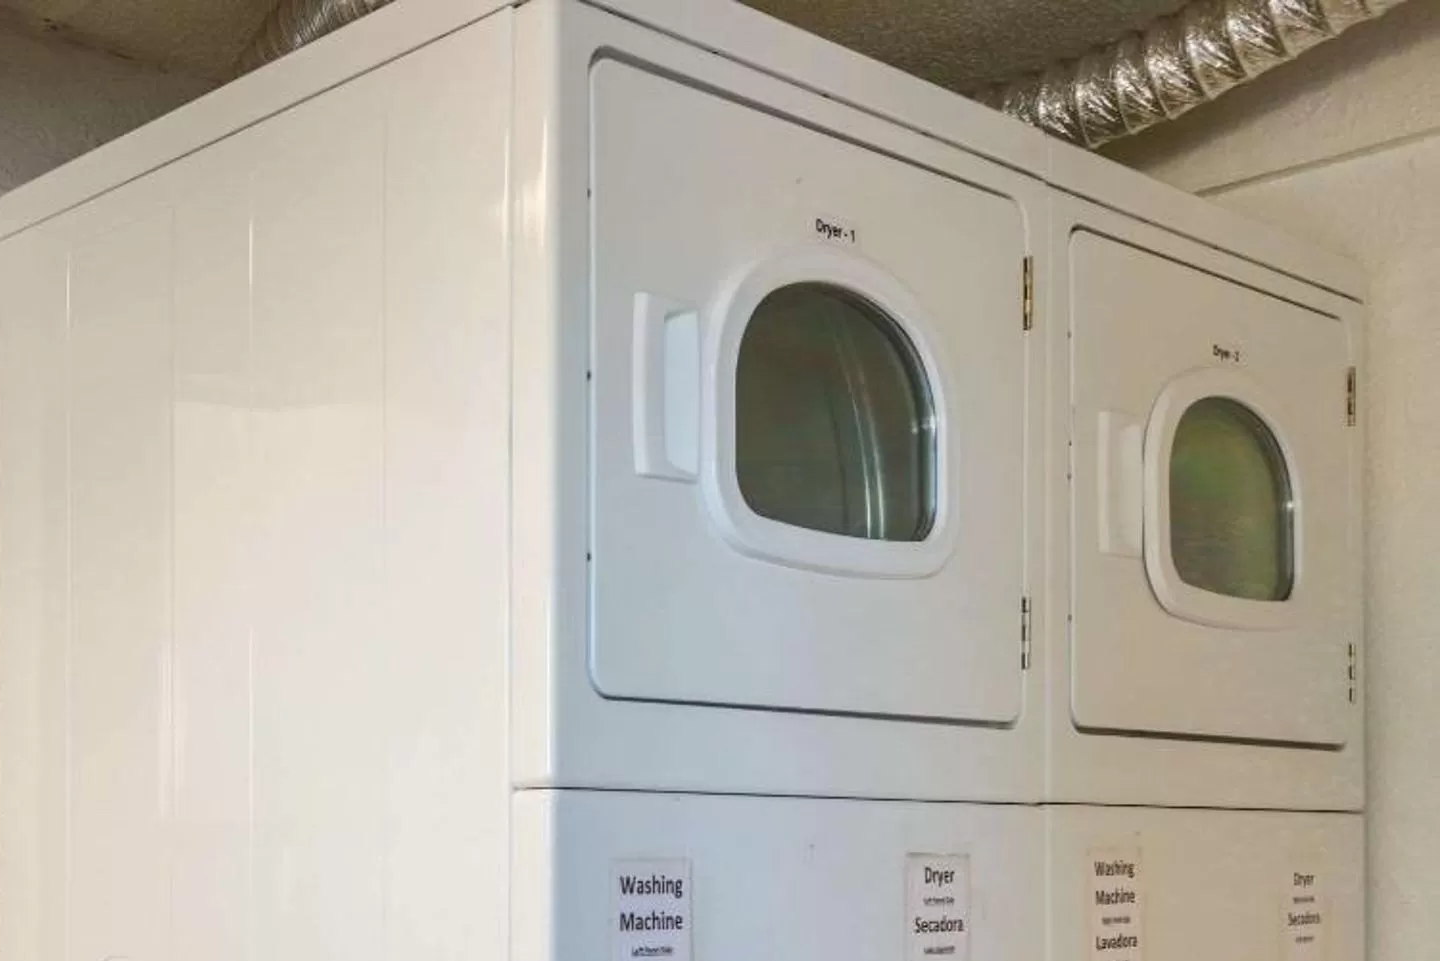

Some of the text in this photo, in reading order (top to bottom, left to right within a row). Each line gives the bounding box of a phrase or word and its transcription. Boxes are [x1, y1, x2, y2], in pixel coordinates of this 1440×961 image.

[815, 218, 842, 239] Dryer
[924, 866, 955, 888] Dryer
[1094, 860, 1135, 878] Washing
[620, 874, 683, 899] Washing
[1293, 872, 1314, 889] Dryer
[1095, 886, 1136, 905] Machine
[620, 910, 684, 932] Machine
[914, 915, 964, 934] Secadora
[1287, 911, 1322, 927] Secadora
[1095, 932, 1138, 951] Lavadora
